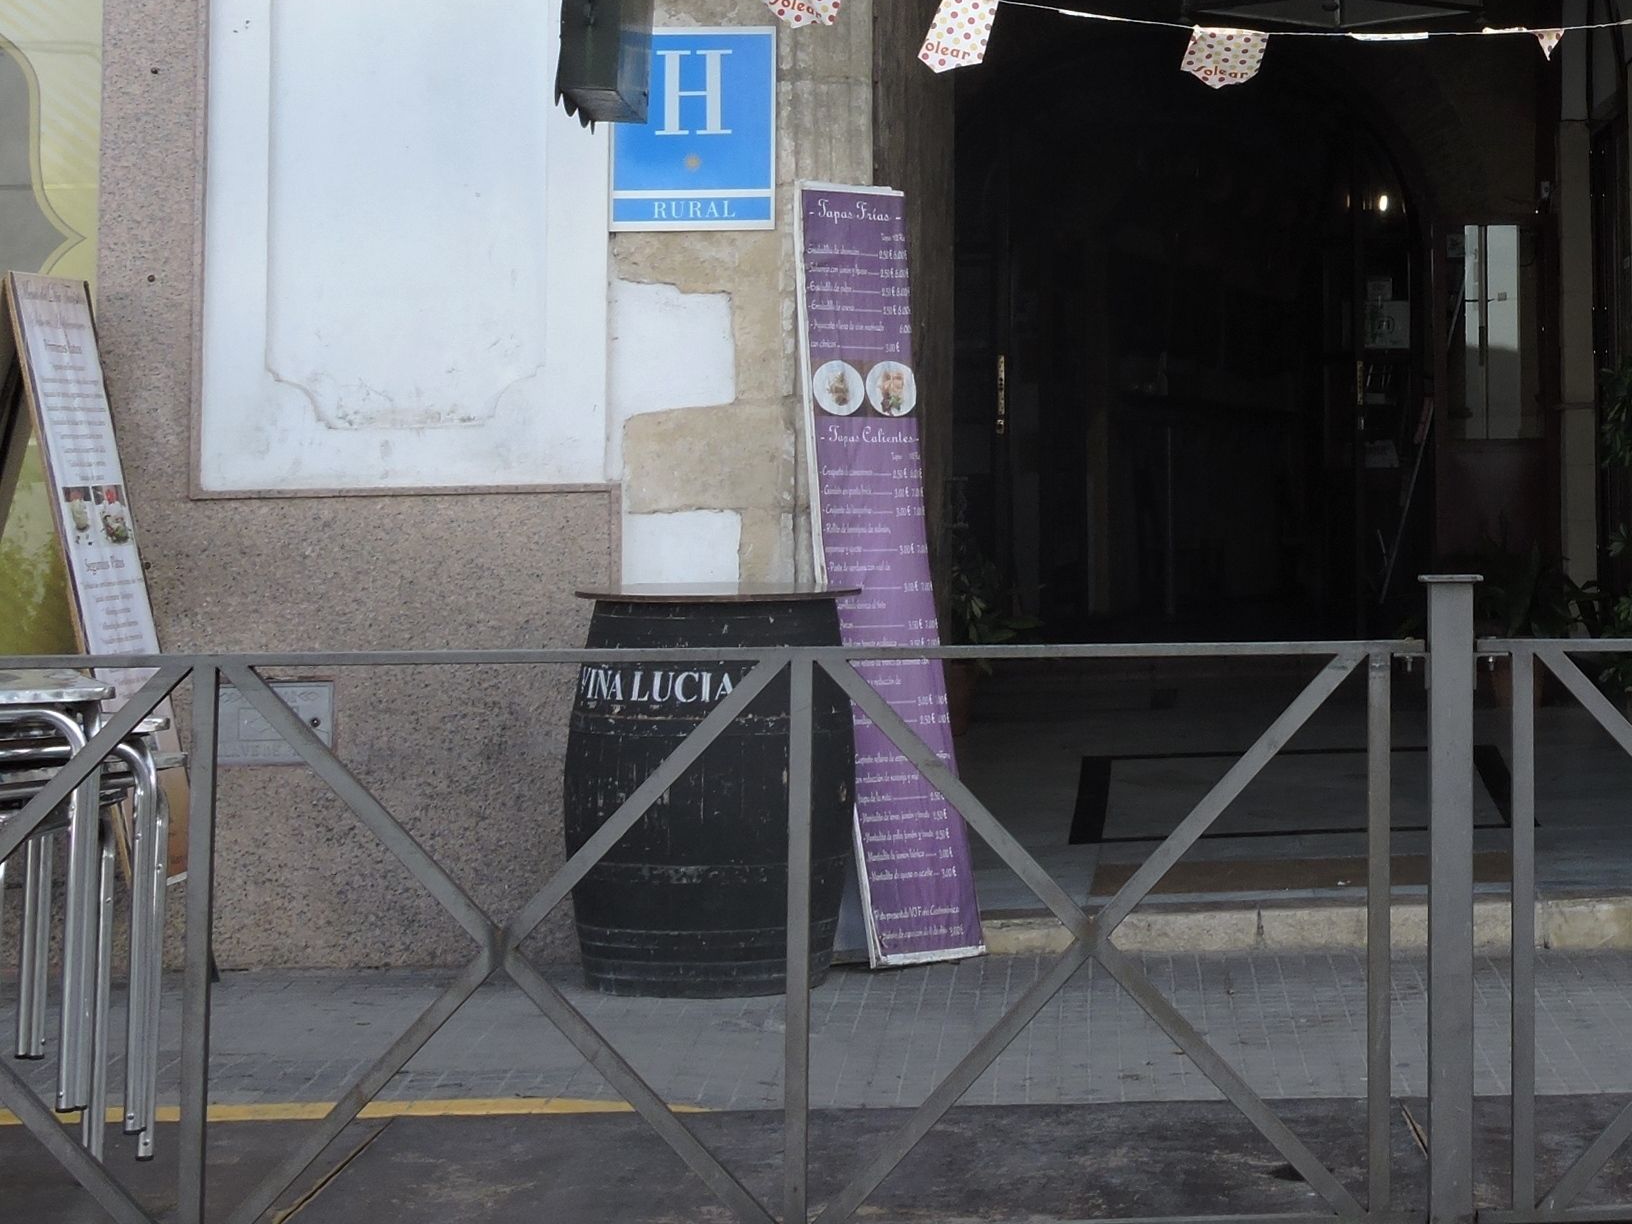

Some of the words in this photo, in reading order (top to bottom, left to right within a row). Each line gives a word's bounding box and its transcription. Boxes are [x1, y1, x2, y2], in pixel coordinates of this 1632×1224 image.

[924, 38, 971, 60] olear
[655, 49, 733, 136] H
[653, 200, 736, 219] RURAL
[818, 198, 854, 224] Tapas
[856, 201, 890, 222] Frías
[828, 424, 859, 447] Tapas
[862, 425, 913, 443] Calientes
[630, 670, 736, 703] LUCIA
